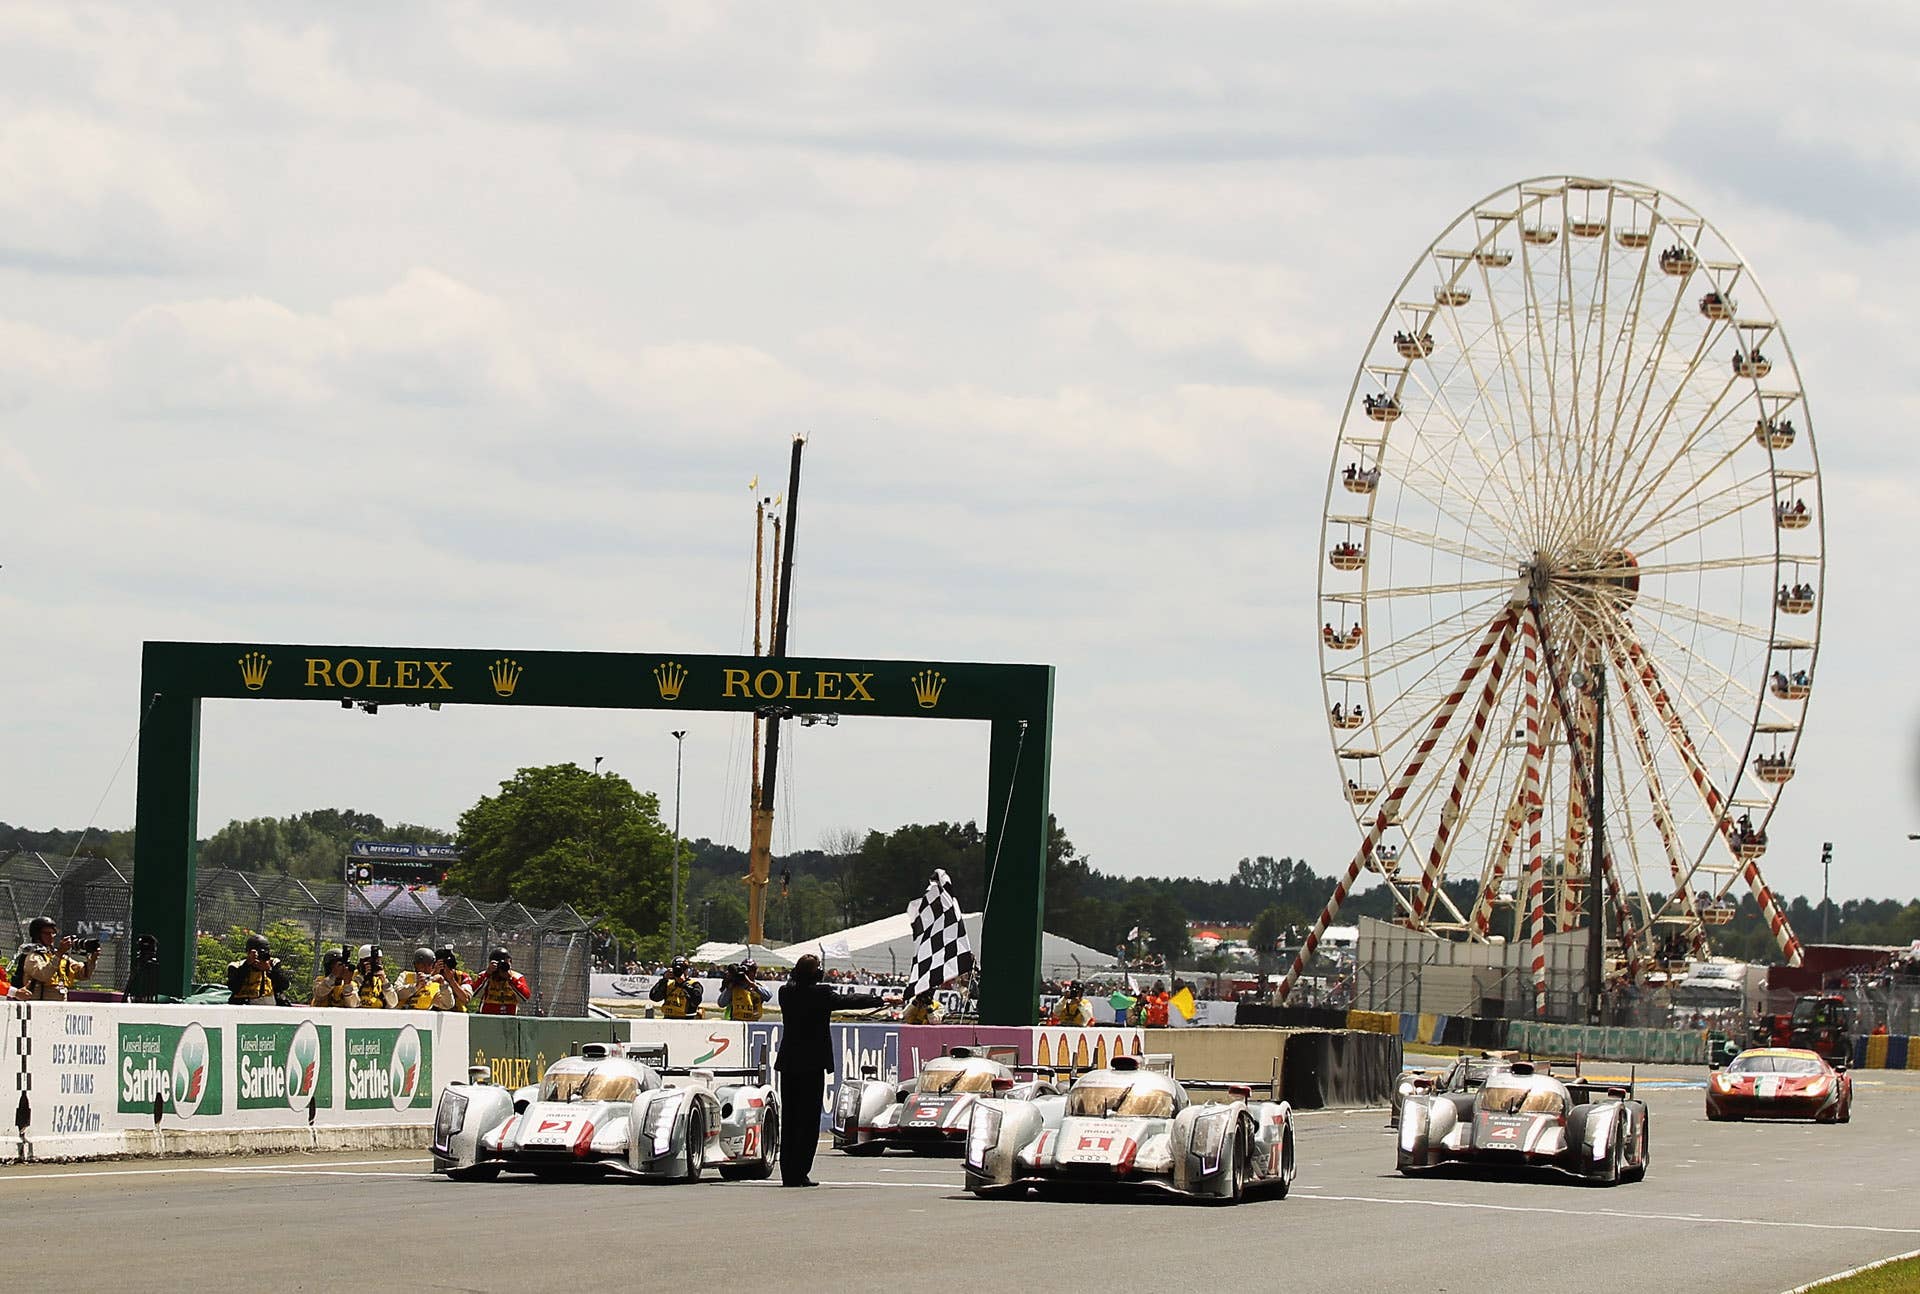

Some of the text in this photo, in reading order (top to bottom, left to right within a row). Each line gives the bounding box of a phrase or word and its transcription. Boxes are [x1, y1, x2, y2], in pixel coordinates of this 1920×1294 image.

[304, 658, 453, 690] ROLEX
[722, 669, 875, 701] ROLEX
[65, 1013, 93, 1036] CIRCUIT
[122, 1034, 142, 1053] Conseil
[240, 1034, 258, 1052] Conseil
[349, 1038, 364, 1056] Conseil
[52, 1044, 106, 1065] DES 24 HEURES
[61, 1073, 94, 1094] DU MANS
[122, 1055, 171, 1103] Sarthe
[241, 1055, 285, 1099] Sarthe
[349, 1058, 389, 1100] Sarthe
[491, 1057, 531, 1091] ROLEX
[916, 1107, 938, 1119] 3
[539, 1120, 569, 1132] 2
[1491, 1127, 1517, 1139] 4
[745, 1128, 755, 1155] 2
[1081, 1136, 1105, 1150] 1
